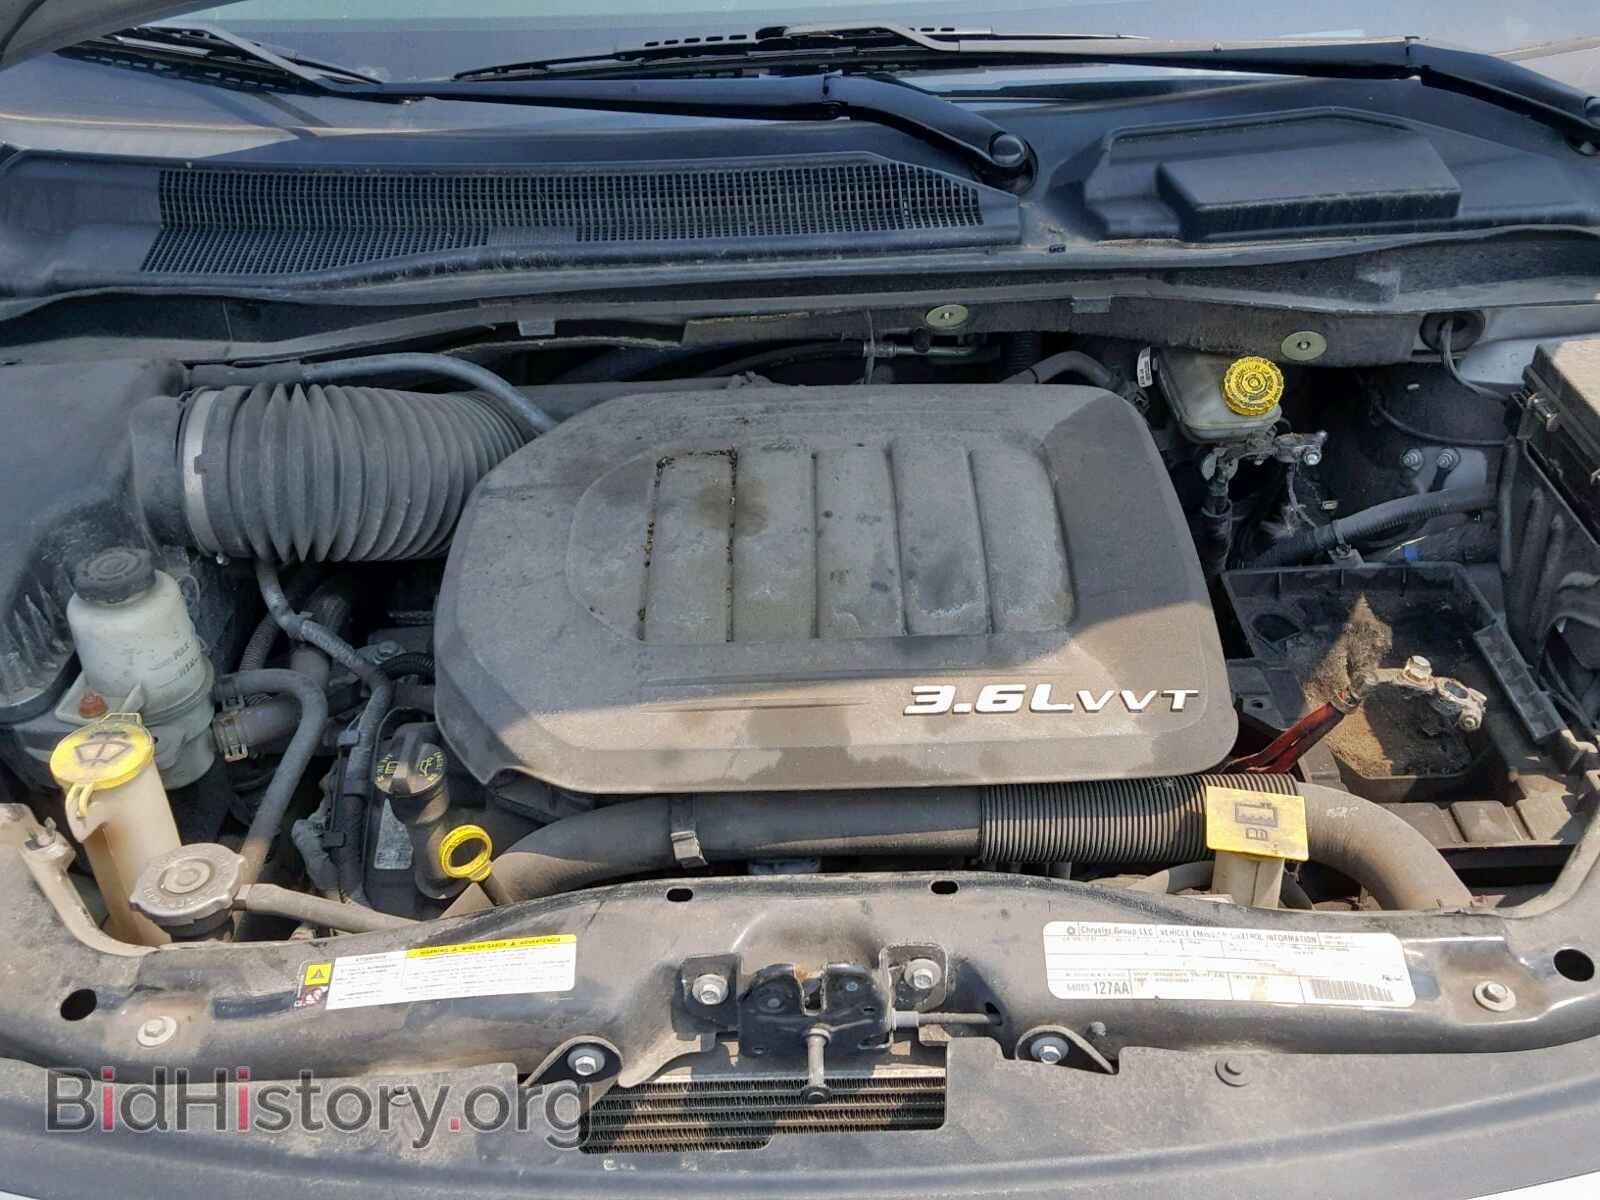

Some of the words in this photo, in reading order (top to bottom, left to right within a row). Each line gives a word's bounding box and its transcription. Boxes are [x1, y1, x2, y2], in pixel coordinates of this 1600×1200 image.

[903, 683, 1075, 716] 3.6L
[1077, 689, 1200, 713] VVT
[1080, 925, 1111, 937] Chrysler
[1094, 981, 1130, 995] 127AA
